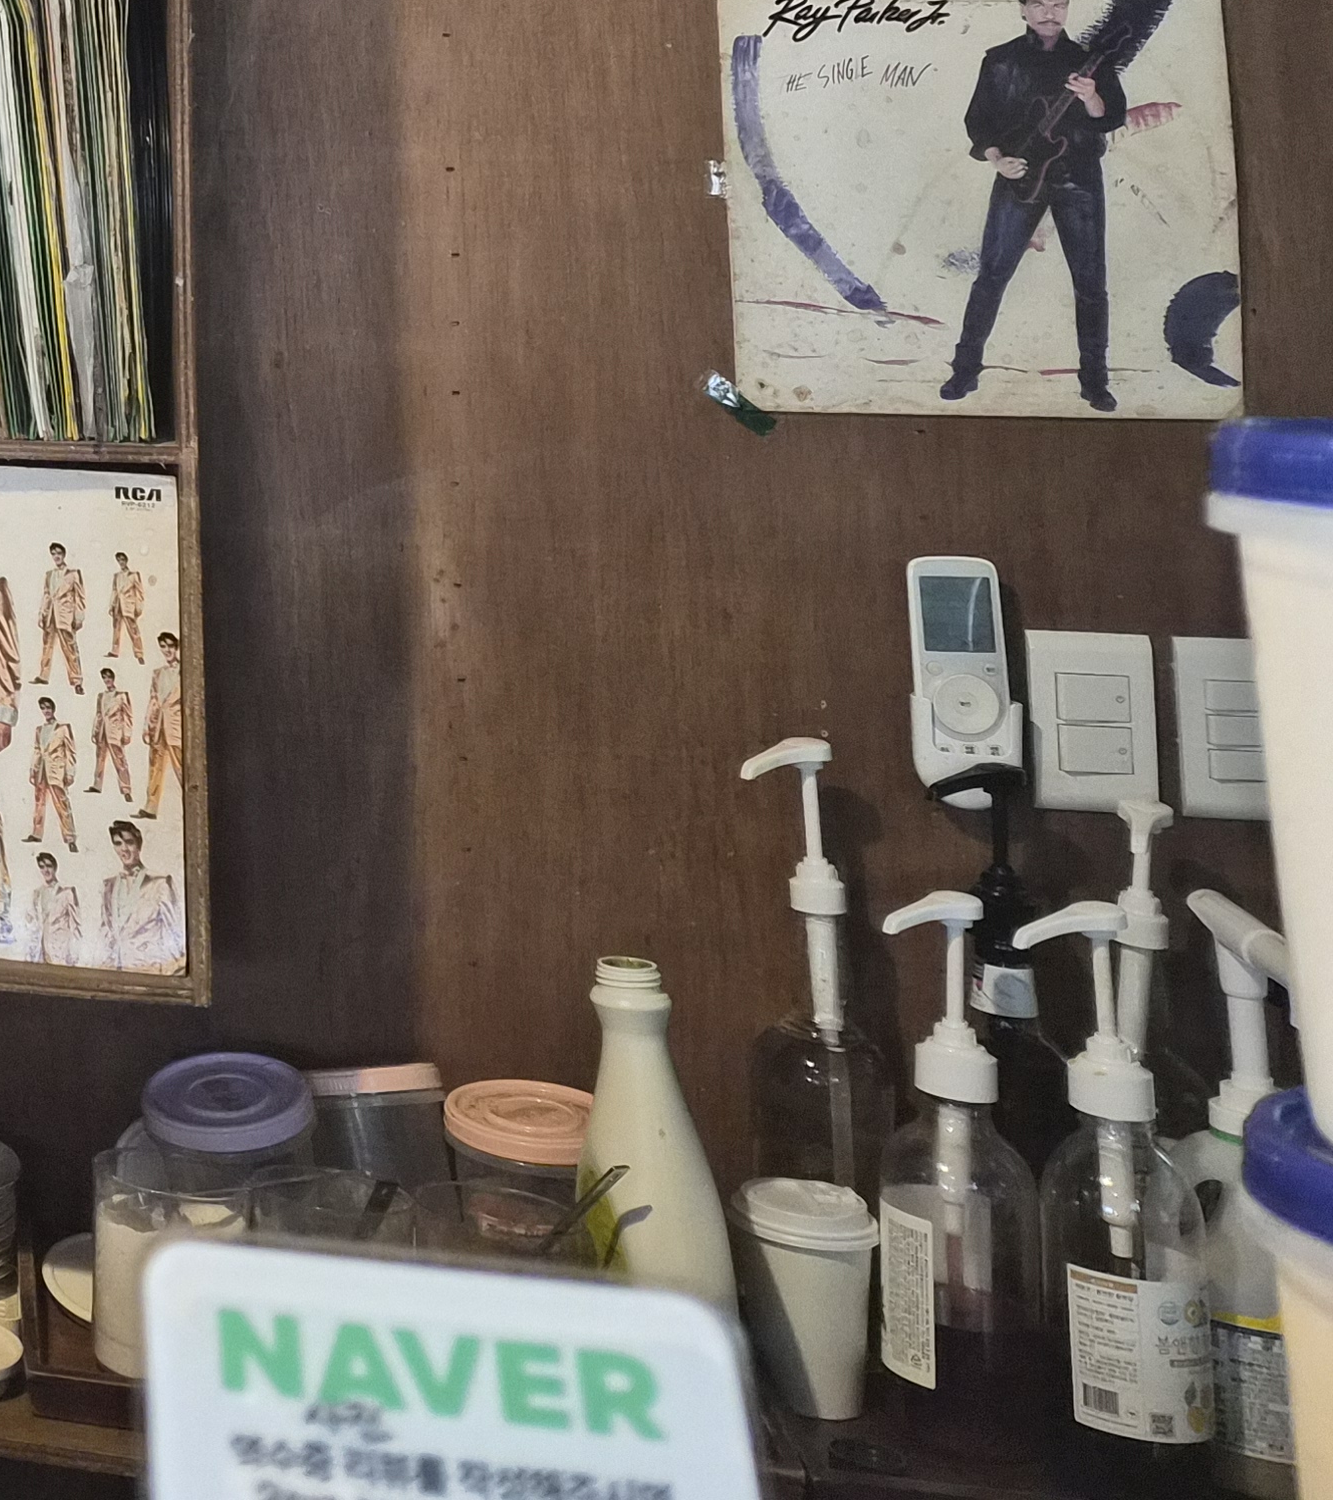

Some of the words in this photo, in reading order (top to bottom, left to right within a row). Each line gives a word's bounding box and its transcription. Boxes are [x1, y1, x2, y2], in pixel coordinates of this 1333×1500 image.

[904, 0, 951, 34] Jr.
[879, 61, 933, 89] MAN
[114, 486, 162, 502] RCA
[217, 1307, 668, 1442] NAVER
